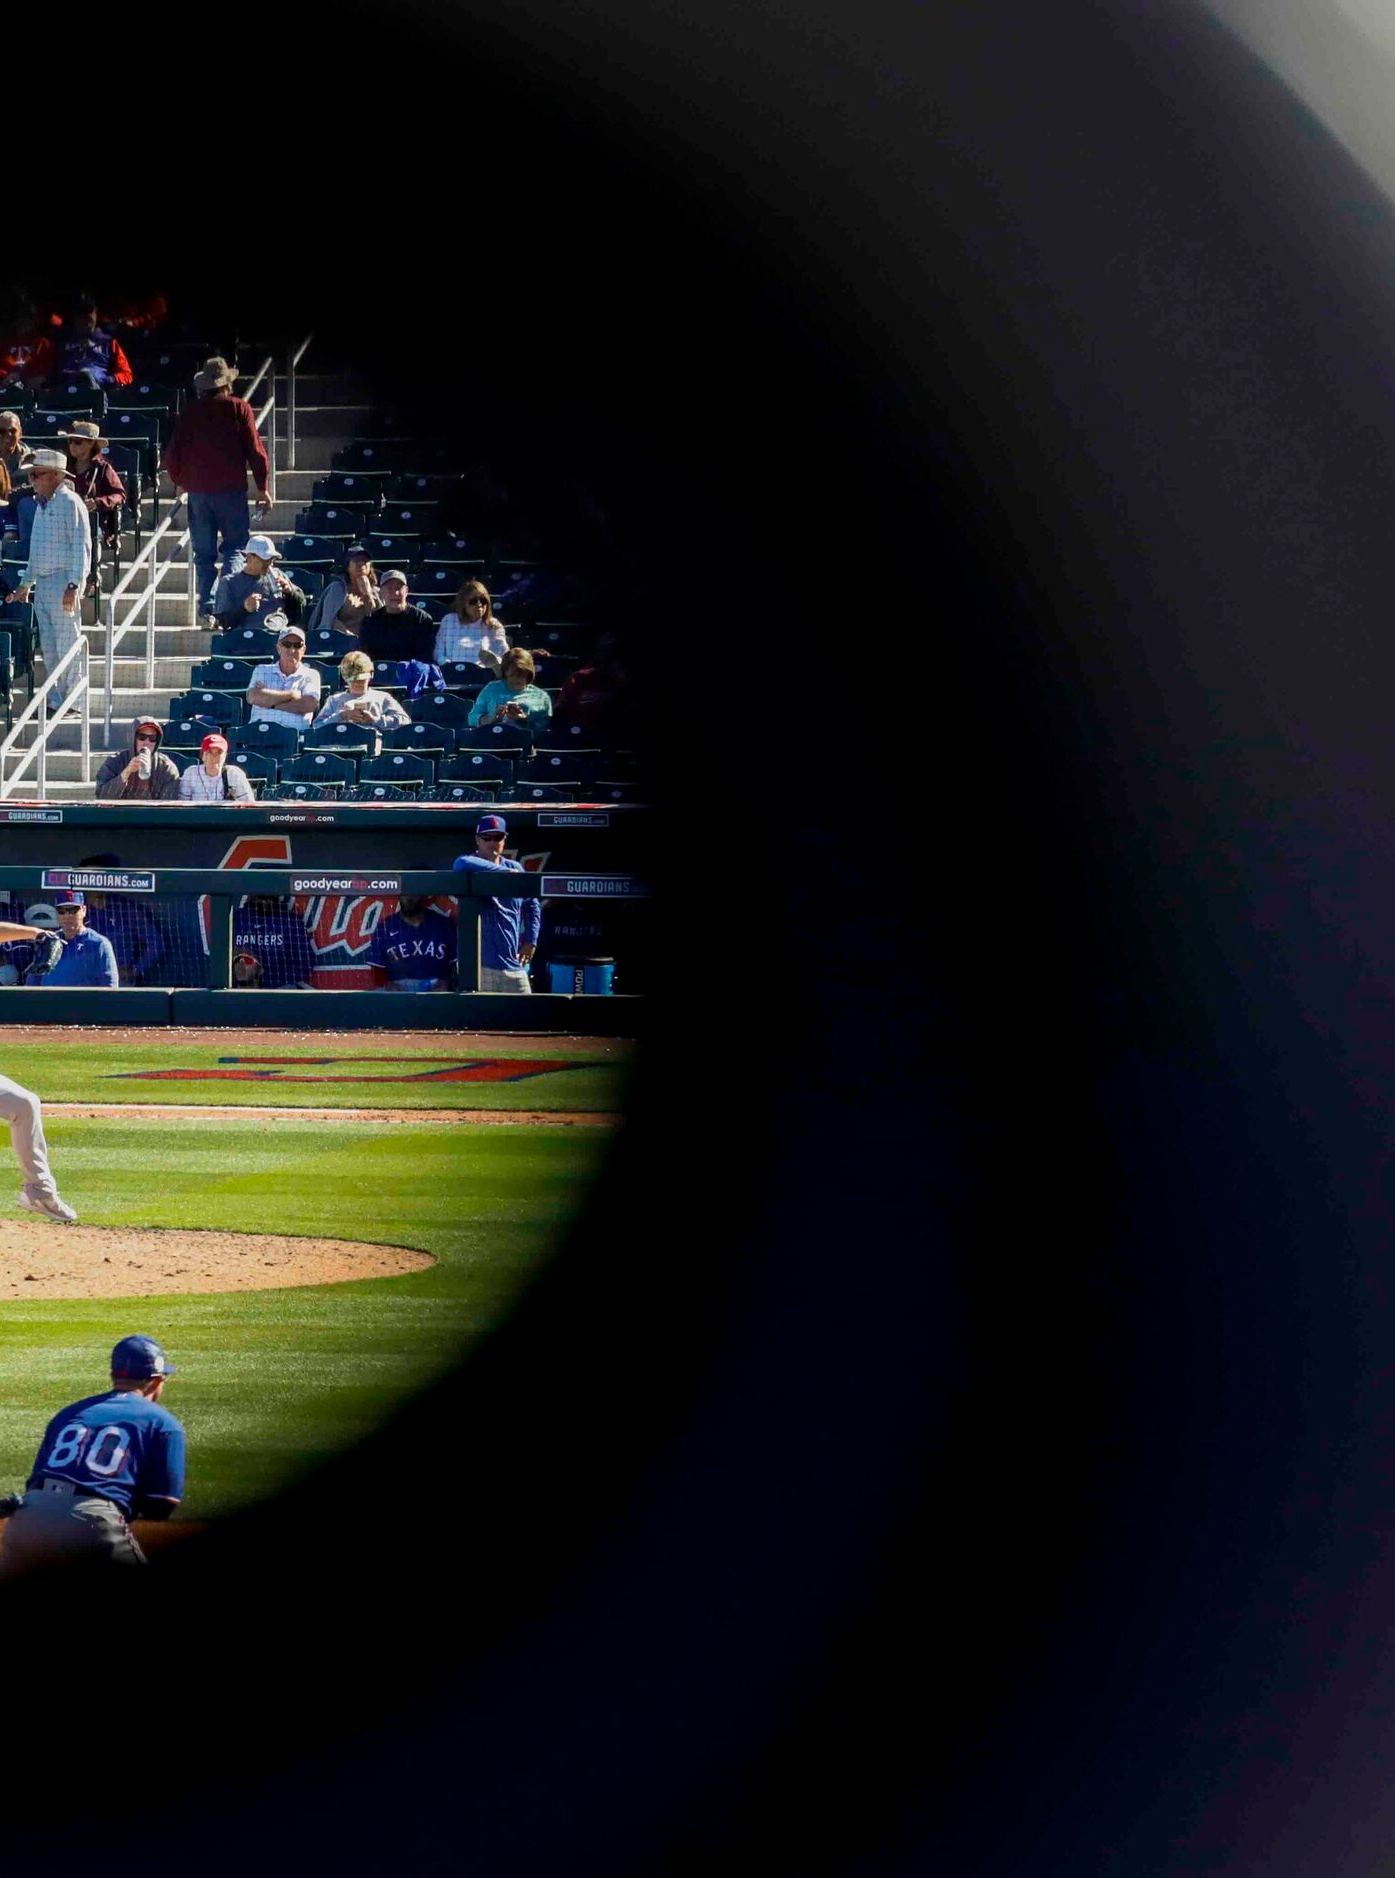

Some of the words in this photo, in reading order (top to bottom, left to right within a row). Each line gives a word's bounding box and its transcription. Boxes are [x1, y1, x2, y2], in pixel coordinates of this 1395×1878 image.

[236, 934, 283, 946] RANGERS
[387, 940, 446, 961] TEXAS
[48, 1423, 132, 1475] 80
